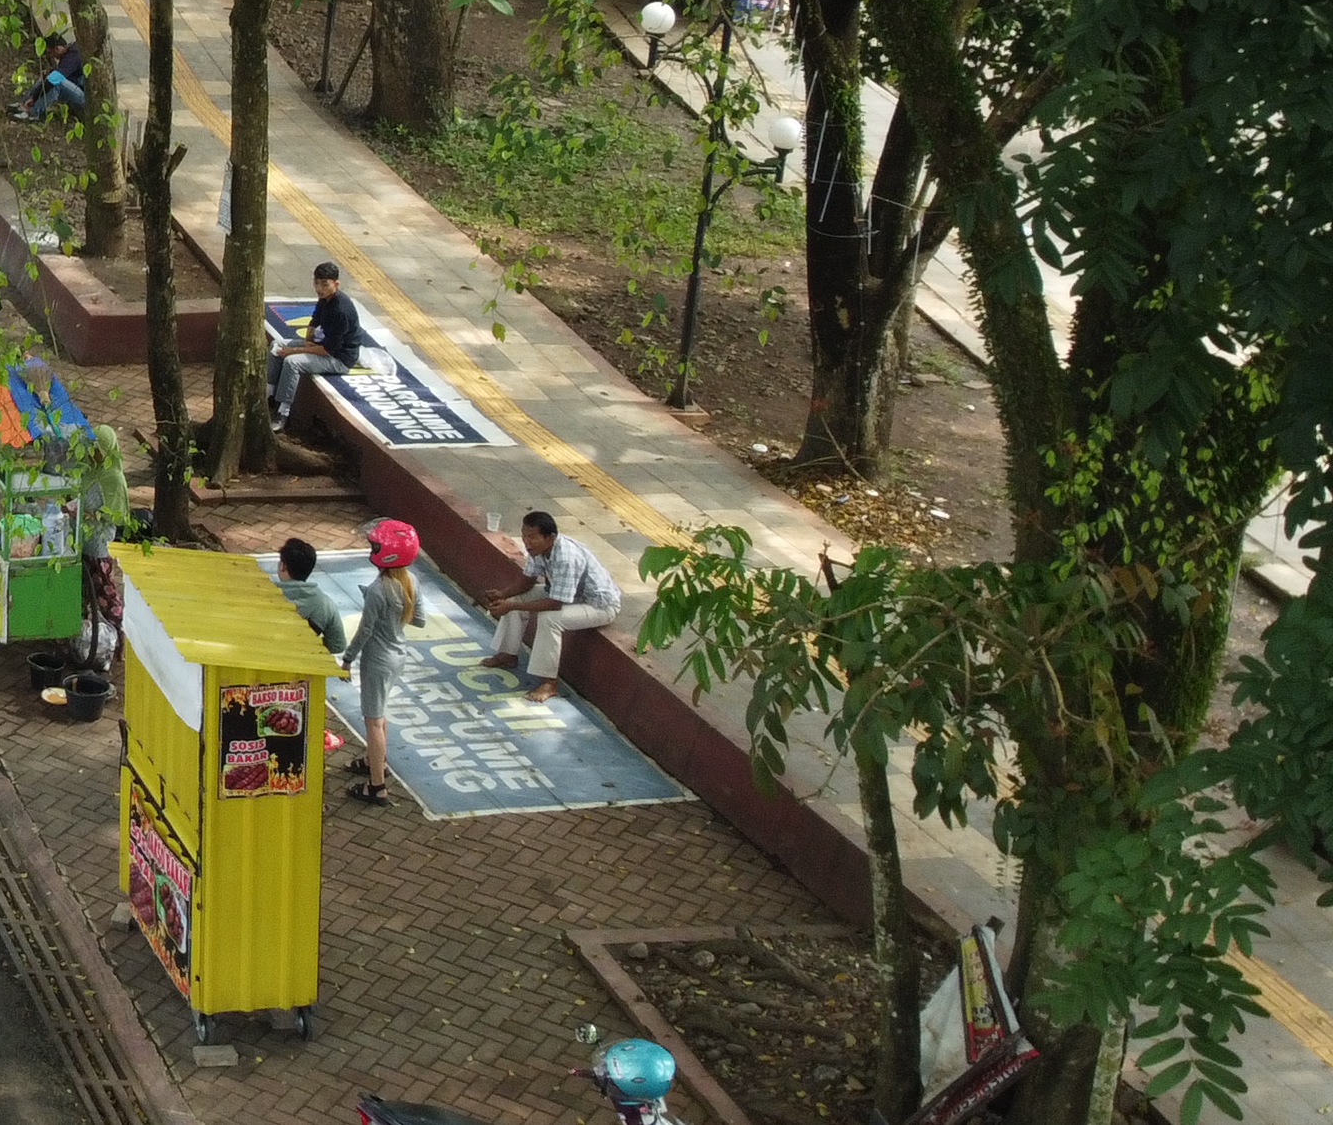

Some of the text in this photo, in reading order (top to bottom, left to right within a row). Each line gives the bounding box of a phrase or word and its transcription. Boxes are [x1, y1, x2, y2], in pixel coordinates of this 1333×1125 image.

[341, 374, 432, 440] BANDUNG
[252, 689, 304, 705] BAKSO BAKAR
[231, 740, 265, 751] SOSIS
[227, 751, 268, 763] BAKAR
